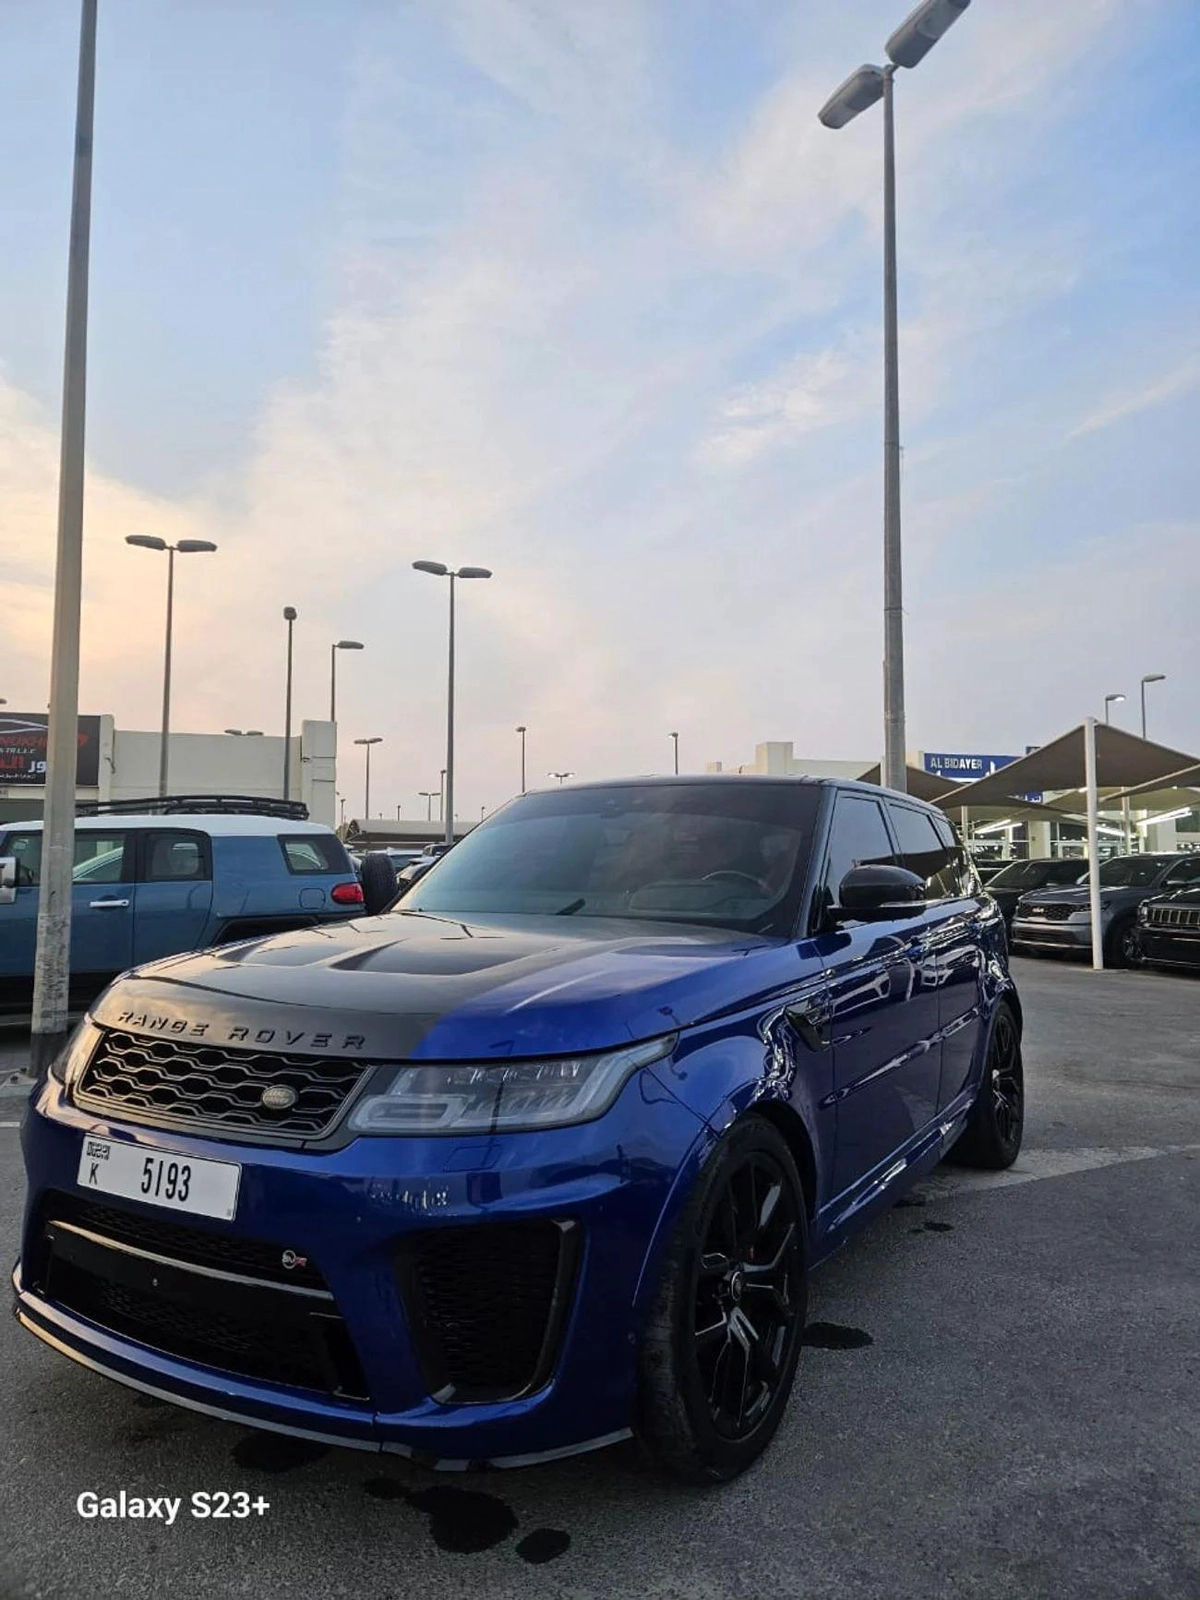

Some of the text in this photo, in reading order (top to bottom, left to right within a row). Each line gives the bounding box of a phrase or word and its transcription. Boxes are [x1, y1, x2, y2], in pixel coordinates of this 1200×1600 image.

[930, 757, 982, 770] AL BIDAYER
[117, 1010, 366, 1050] RANGE ROVER
[88, 1157, 191, 1202] K 5193
